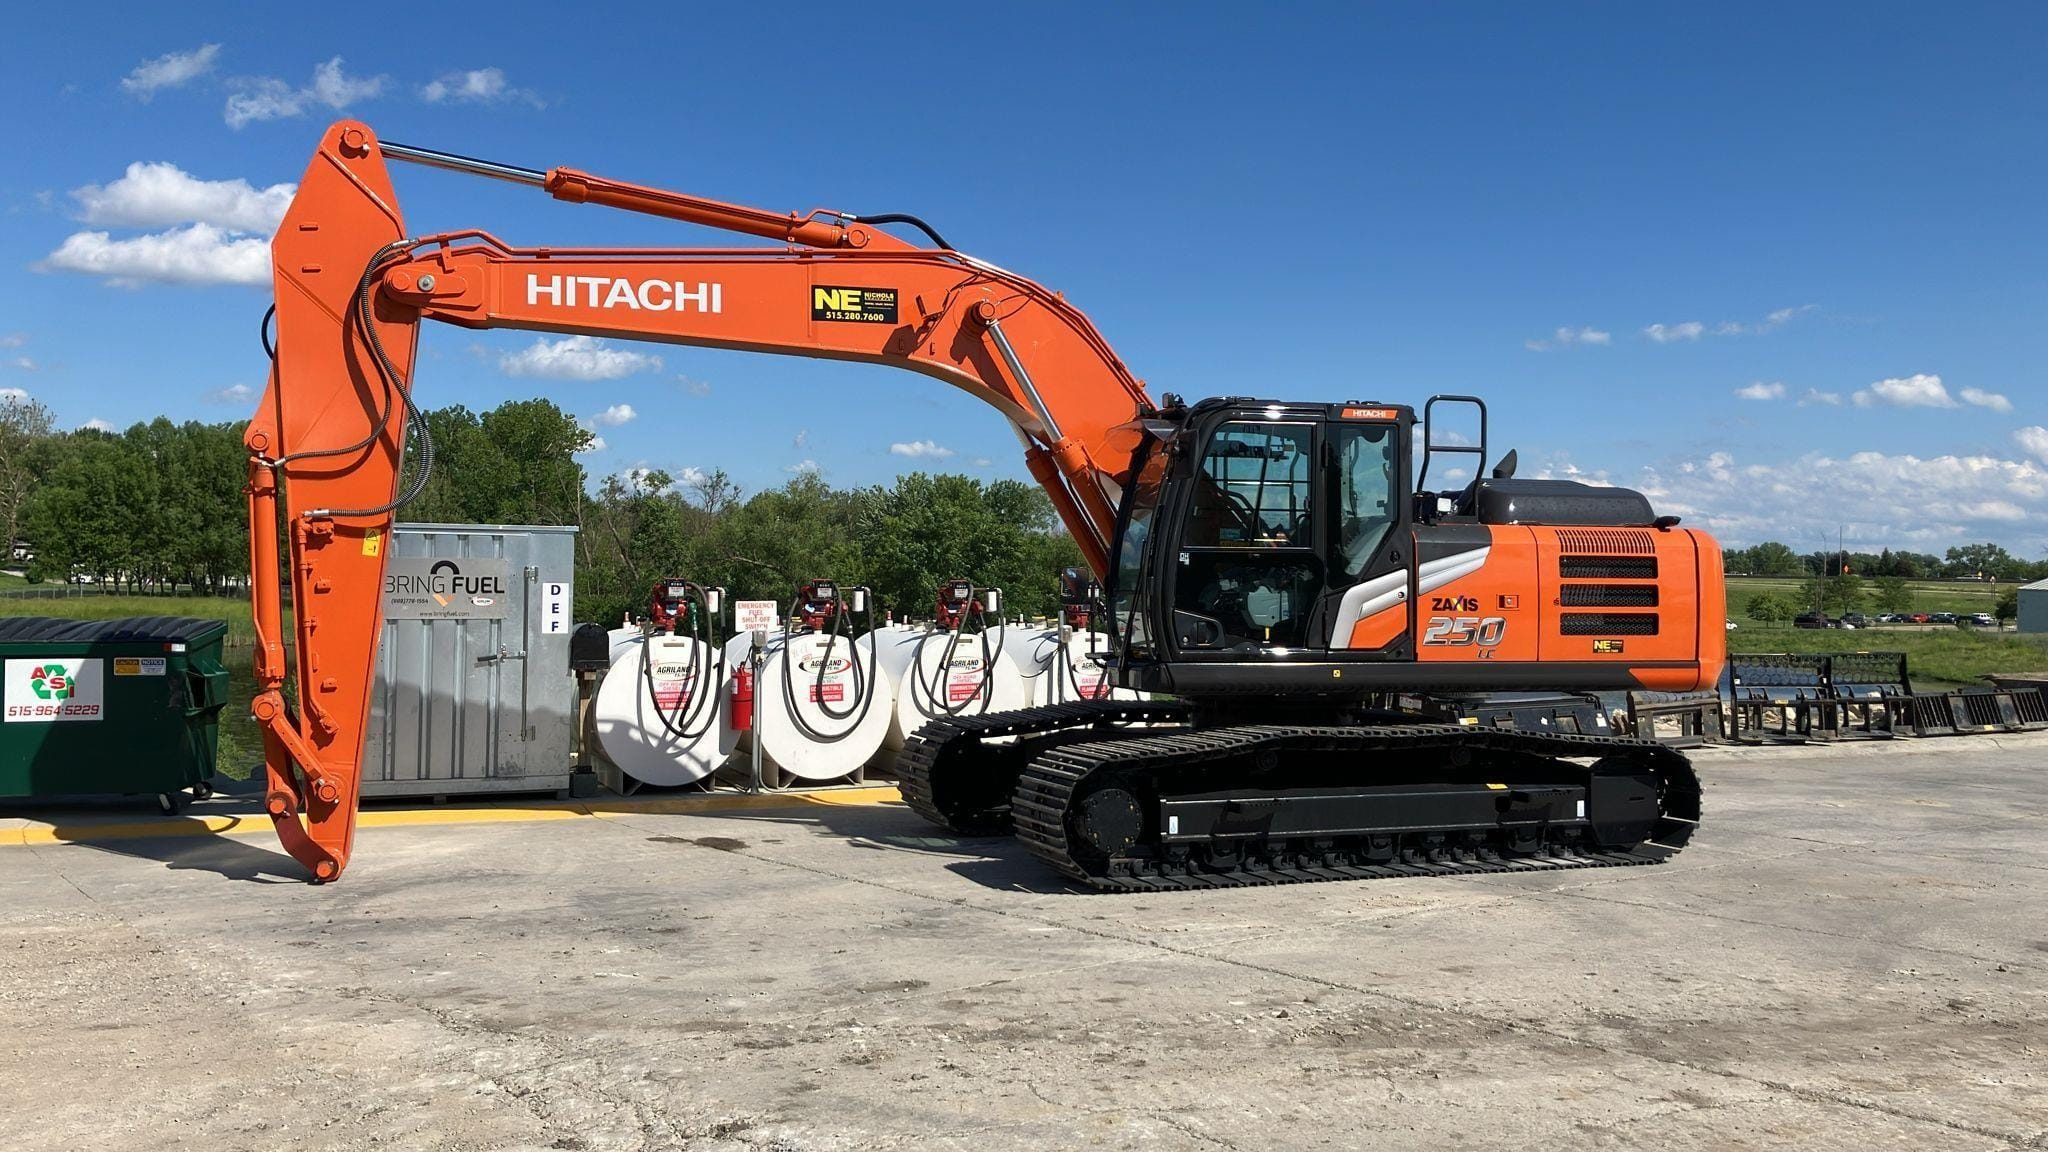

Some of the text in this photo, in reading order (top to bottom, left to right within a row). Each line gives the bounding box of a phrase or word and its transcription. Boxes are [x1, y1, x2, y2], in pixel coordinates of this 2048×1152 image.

[527, 273, 722, 313] HITACHI
[814, 288, 862, 311] NE
[825, 311, 885, 322] 515.280.7600
[1353, 409, 1385, 418] HITACHI
[452, 576, 505, 594] FUEL
[737, 602, 775, 610] EMERGENCY
[1431, 595, 1479, 612] ZAXIS
[419, 610, 470, 618] www.bringfuel.com
[744, 623, 769, 631] SWITCH
[1422, 616, 1507, 646] 250
[1594, 640, 1611, 650] NE
